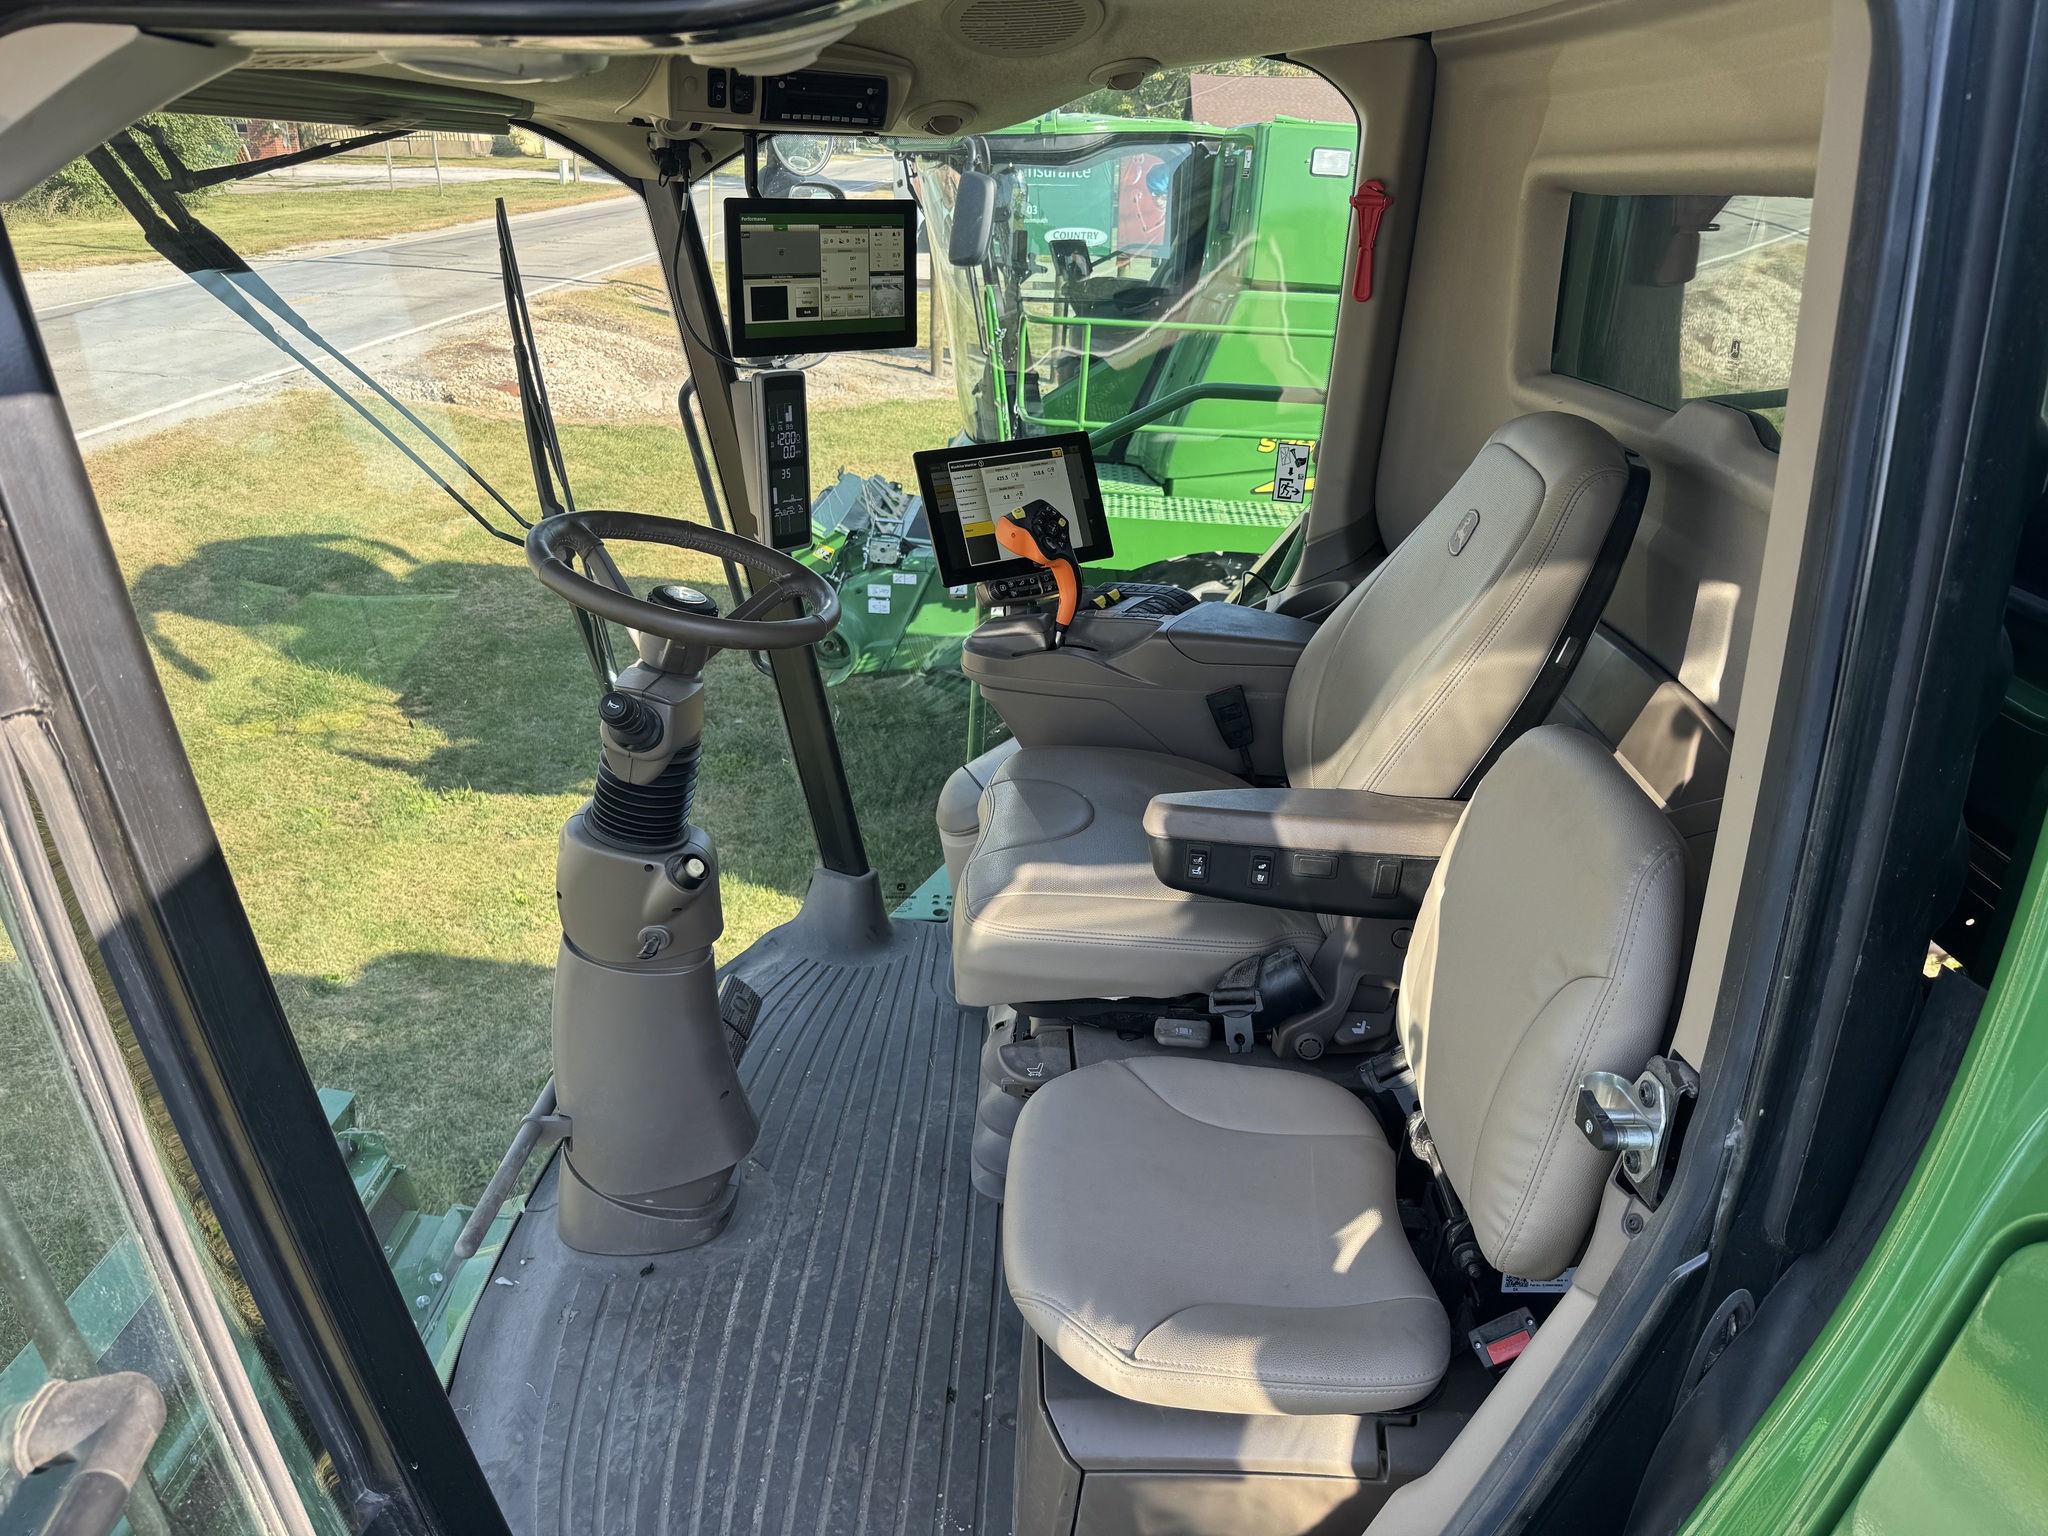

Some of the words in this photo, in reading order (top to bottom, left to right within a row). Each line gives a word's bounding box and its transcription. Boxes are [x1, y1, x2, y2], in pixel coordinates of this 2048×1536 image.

[1053, 231, 1099, 240] COUNTRY
[778, 432, 796, 446] 1200
[783, 446, 796, 459] 0.0
[782, 468, 791, 479] 35
